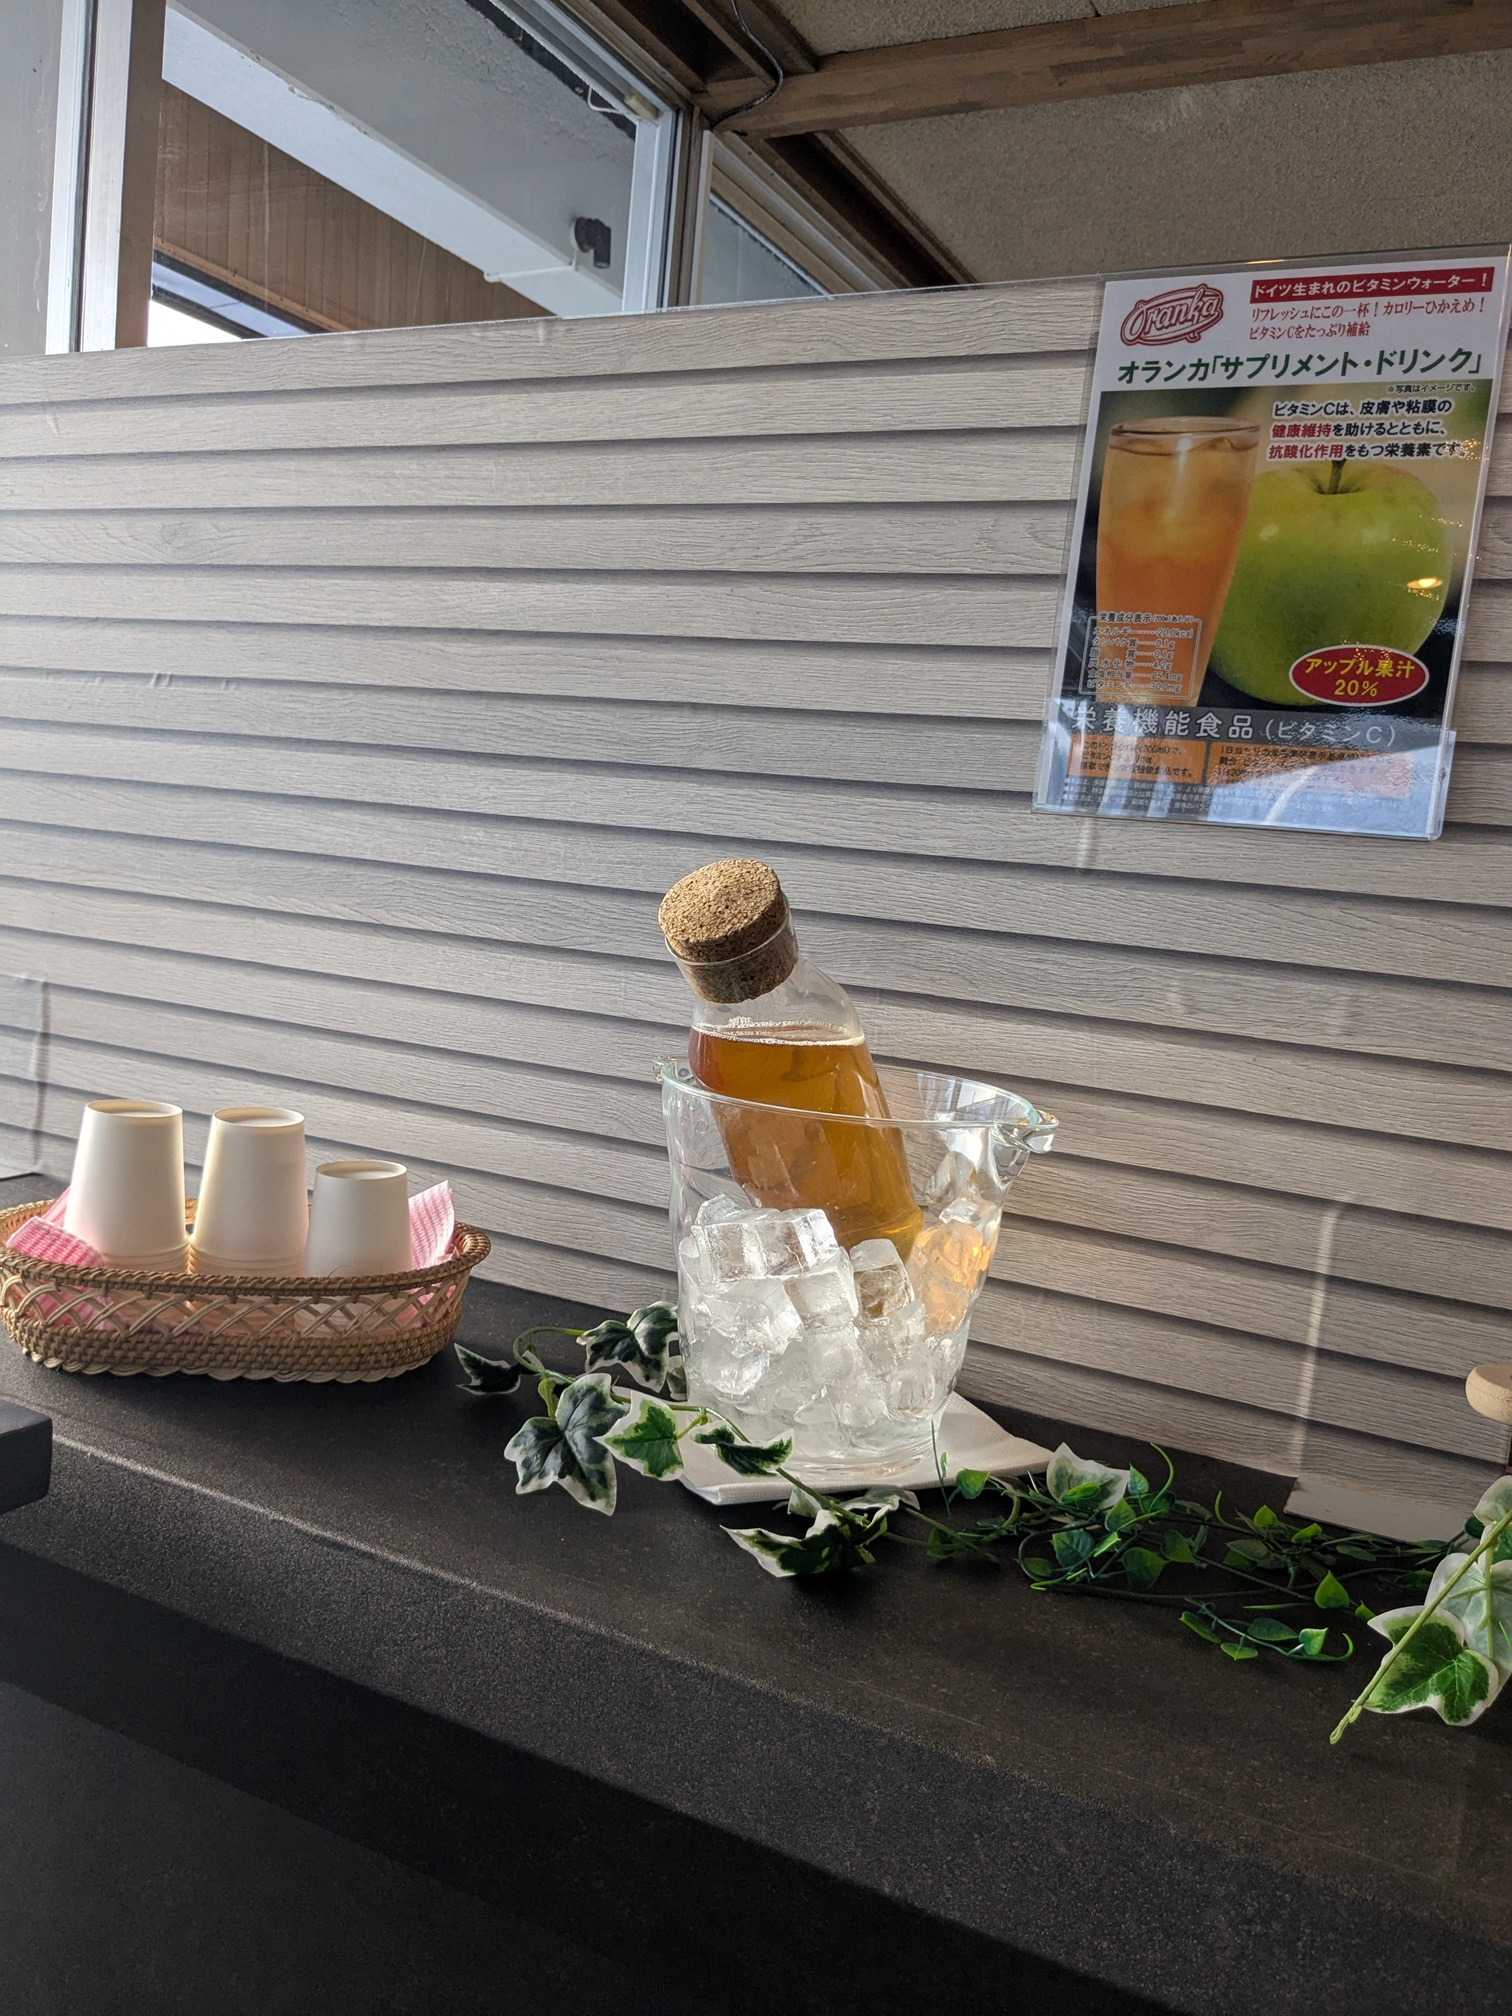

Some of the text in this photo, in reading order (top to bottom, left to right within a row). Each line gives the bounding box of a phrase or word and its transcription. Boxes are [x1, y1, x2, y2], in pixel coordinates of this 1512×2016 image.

[1254, 273, 1487, 299] ドイツ生まれのビタミンウォーター！
[1122, 285, 1221, 343] Oranka
[1249, 321, 1371, 341] ビタミンCをたっぷり補給
[1117, 346, 1483, 385] オランカ「サプリメント・ドリンク」
[1273, 399, 1453, 417] ビタミンCは、皮膚や粘膜の
[1305, 658, 1416, 679] アップル果汁
[1334, 679, 1379, 697] 20%
